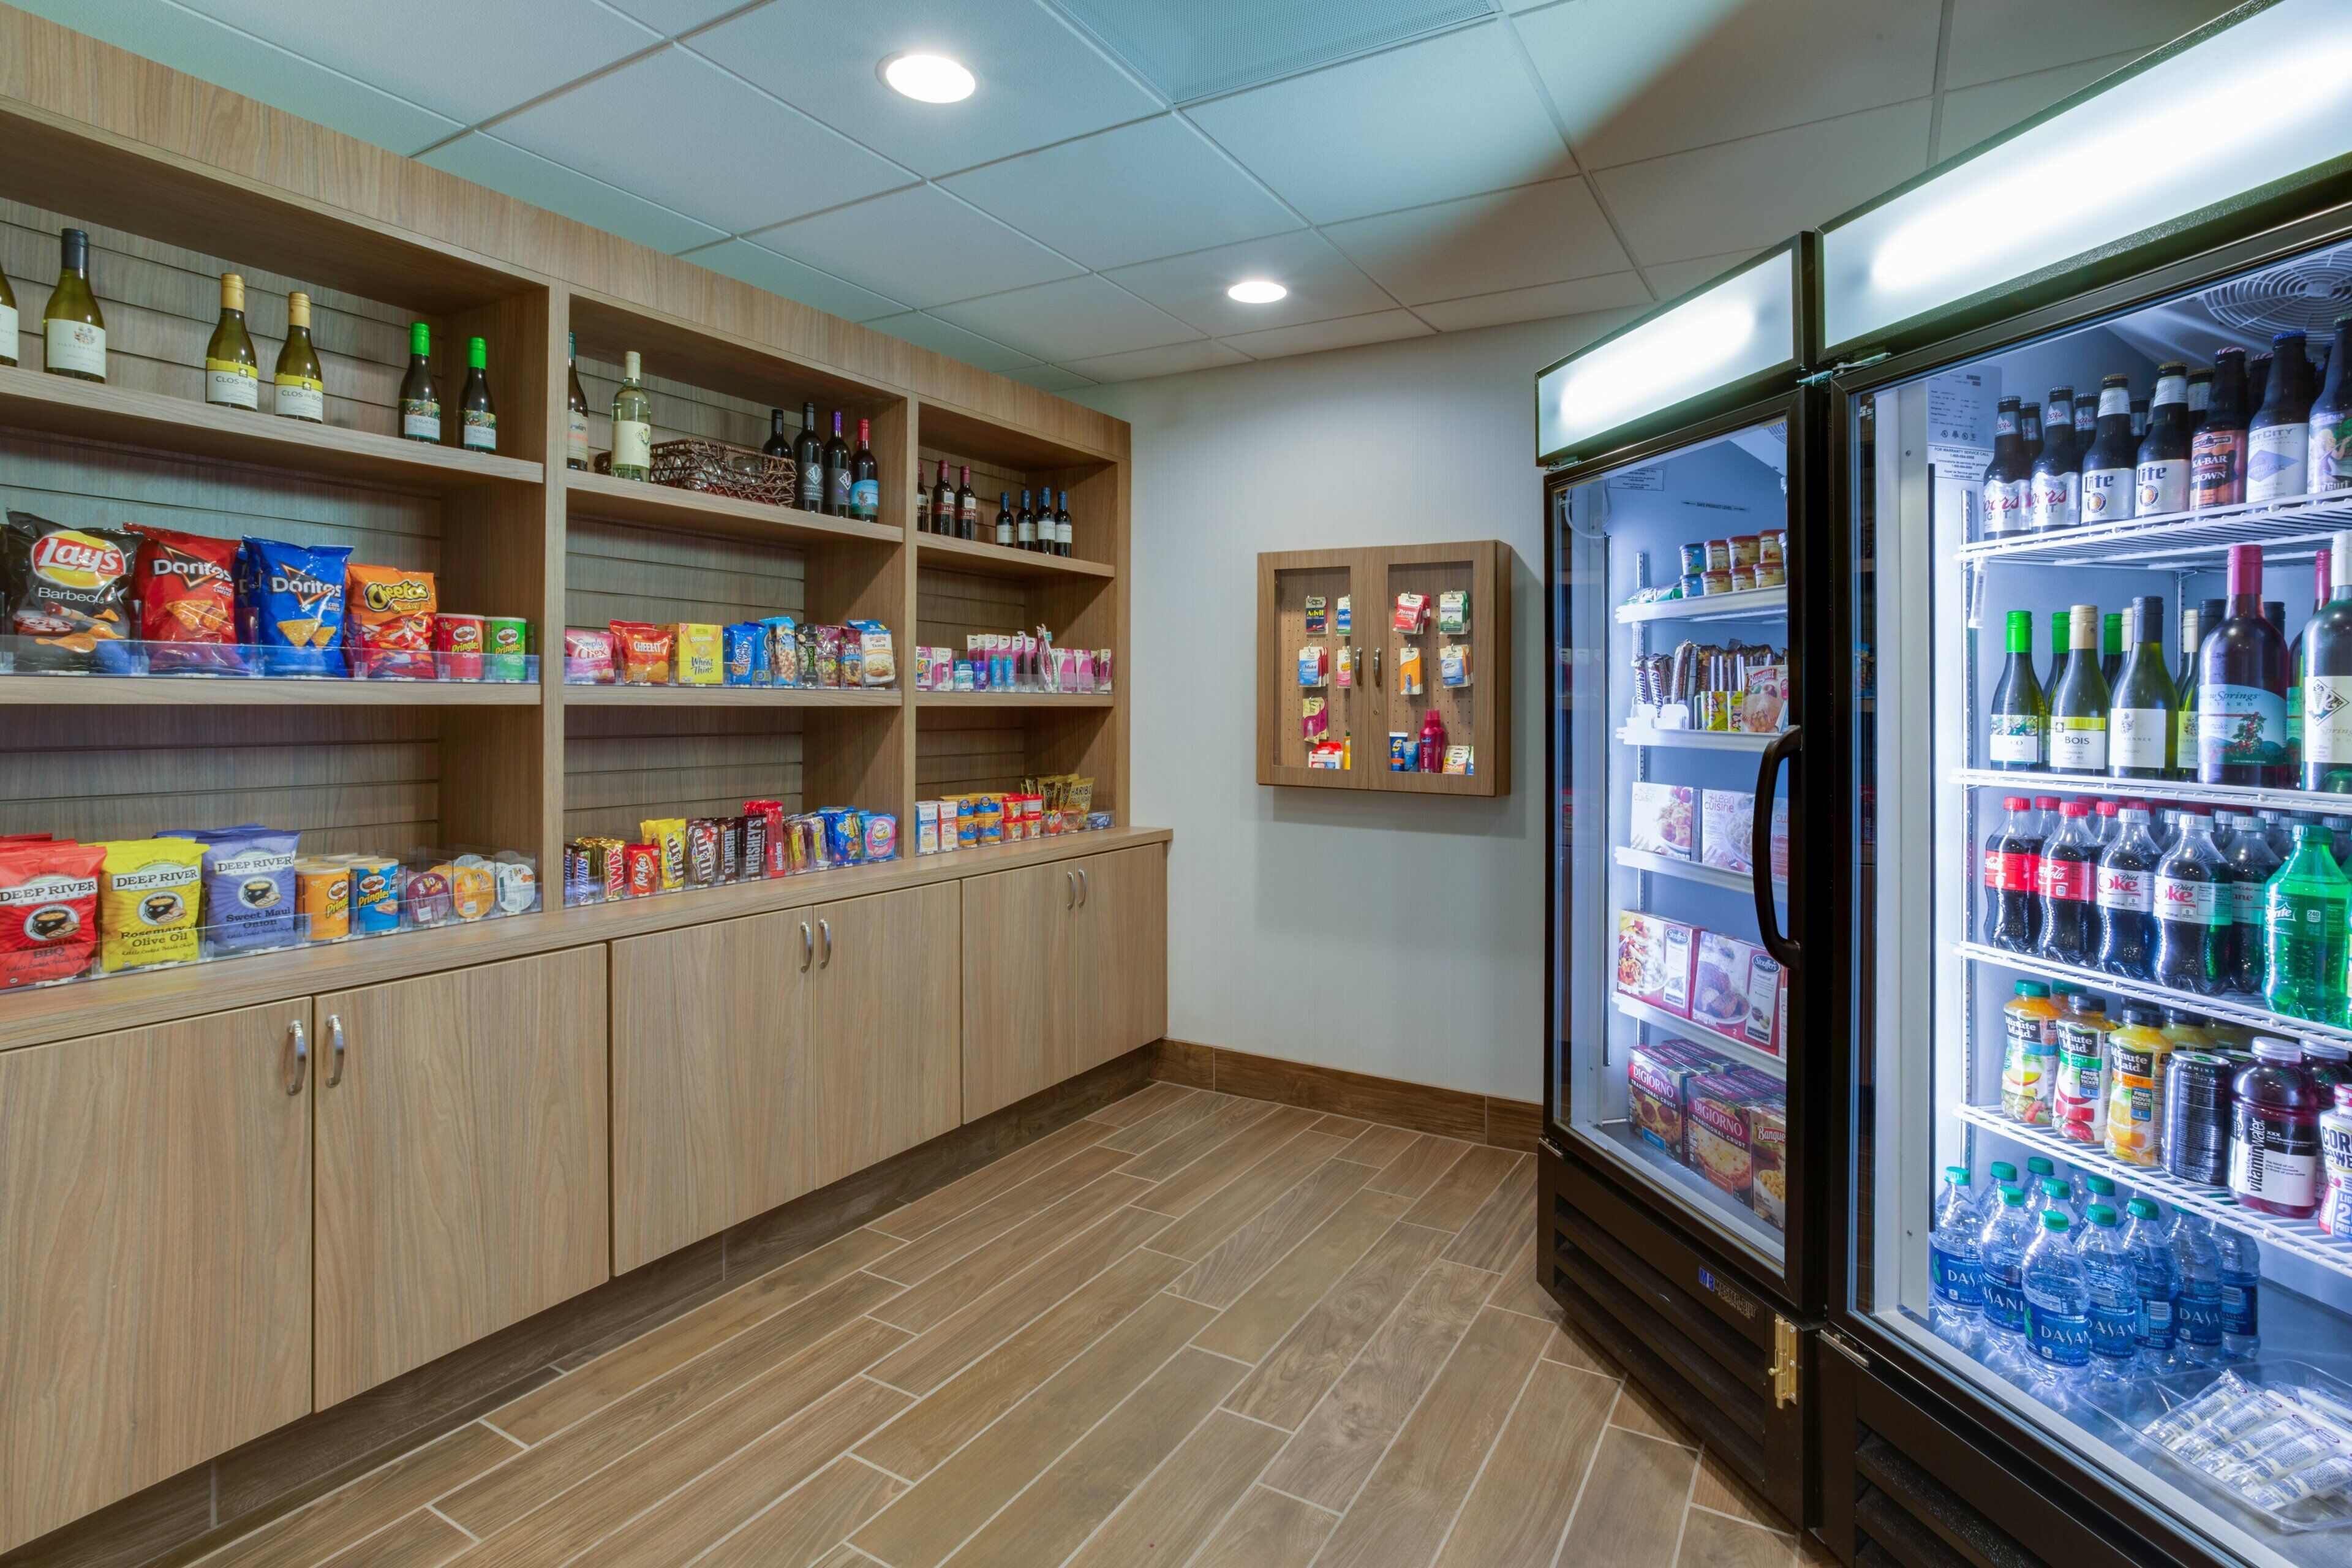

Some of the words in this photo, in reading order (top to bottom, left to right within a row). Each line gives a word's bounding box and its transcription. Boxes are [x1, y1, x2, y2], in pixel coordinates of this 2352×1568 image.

[216, 375, 239, 385] CLOS
[281, 389, 303, 398] CLOS
[2263, 428, 2294, 439] CITY
[2193, 455, 2228, 469] KA-BAR
[2136, 466, 2167, 483] Lite
[2192, 471, 2226, 484] BROWN
[2084, 474, 2114, 493] Lite
[38, 537, 124, 576] Lay's
[153, 559, 233, 582] Doritos
[213, 583, 233, 592] NACHO
[213, 588, 232, 597] CHEESE
[272, 576, 342, 598] Doritos
[366, 579, 429, 611] Cheetos
[452, 641, 479, 657] Pringles
[494, 641, 521, 659] Pringles
[576, 638, 603, 649] Simply
[578, 647, 607, 659] Chex
[691, 655, 714, 666] Wheat
[692, 665, 714, 674] Thins
[1748, 668, 1777, 687] Banquet
[2064, 736, 2090, 745] BOIS
[1071, 785, 1091, 796] HARIBO
[724, 829, 735, 875] HERSHEY'S
[745, 819, 761, 875] HERSHEY'S
[217, 861, 251, 872] DEEP
[253, 856, 292, 869] RIVER
[606, 844, 624, 899] TWIX
[116, 875, 157, 888] DEEP
[159, 869, 198, 882] RIVER
[2119, 872, 2139, 881] Diet
[0, 887, 45, 902] DEEP
[48, 881, 96, 895] RIVER
[2173, 882, 2194, 892] Diet
[357, 888, 390, 908] Pringles
[225, 911, 262, 922] Sweet
[265, 907, 291, 918] Maui
[243, 919, 278, 929] Onion
[120, 925, 186, 940] Rosemary
[132, 937, 166, 948] Olive
[170, 932, 188, 942] Oil
[1667, 930, 1687, 942] Stouffer's
[33, 947, 66, 959] BBQ
[1754, 956, 1777, 970] Stouffer's
[2005, 1015, 2037, 1031] Minute
[2007, 1024, 2031, 1039] Maid
[2058, 1028, 2093, 1046] Minute
[2062, 1038, 2087, 1054] Maid
[1633, 1065, 1674, 1098] DIGIORNO
[2180, 1072, 2207, 1082] Nutrition
[1631, 1079, 1659, 1101] TRADITIONAL
[1660, 1096, 1676, 1109] CRUST
[1694, 1099, 1743, 1137] DIGIORNO
[1692, 1114, 1725, 1139] TRADITIONAL
[1726, 1134, 1746, 1148] CRUST
[1757, 1126, 1786, 1144] Banque
[2247, 1117, 2266, 1192] vitaminwater
[1948, 1269, 1983, 1287] DASA
[2179, 1307, 2220, 1327] DASA
